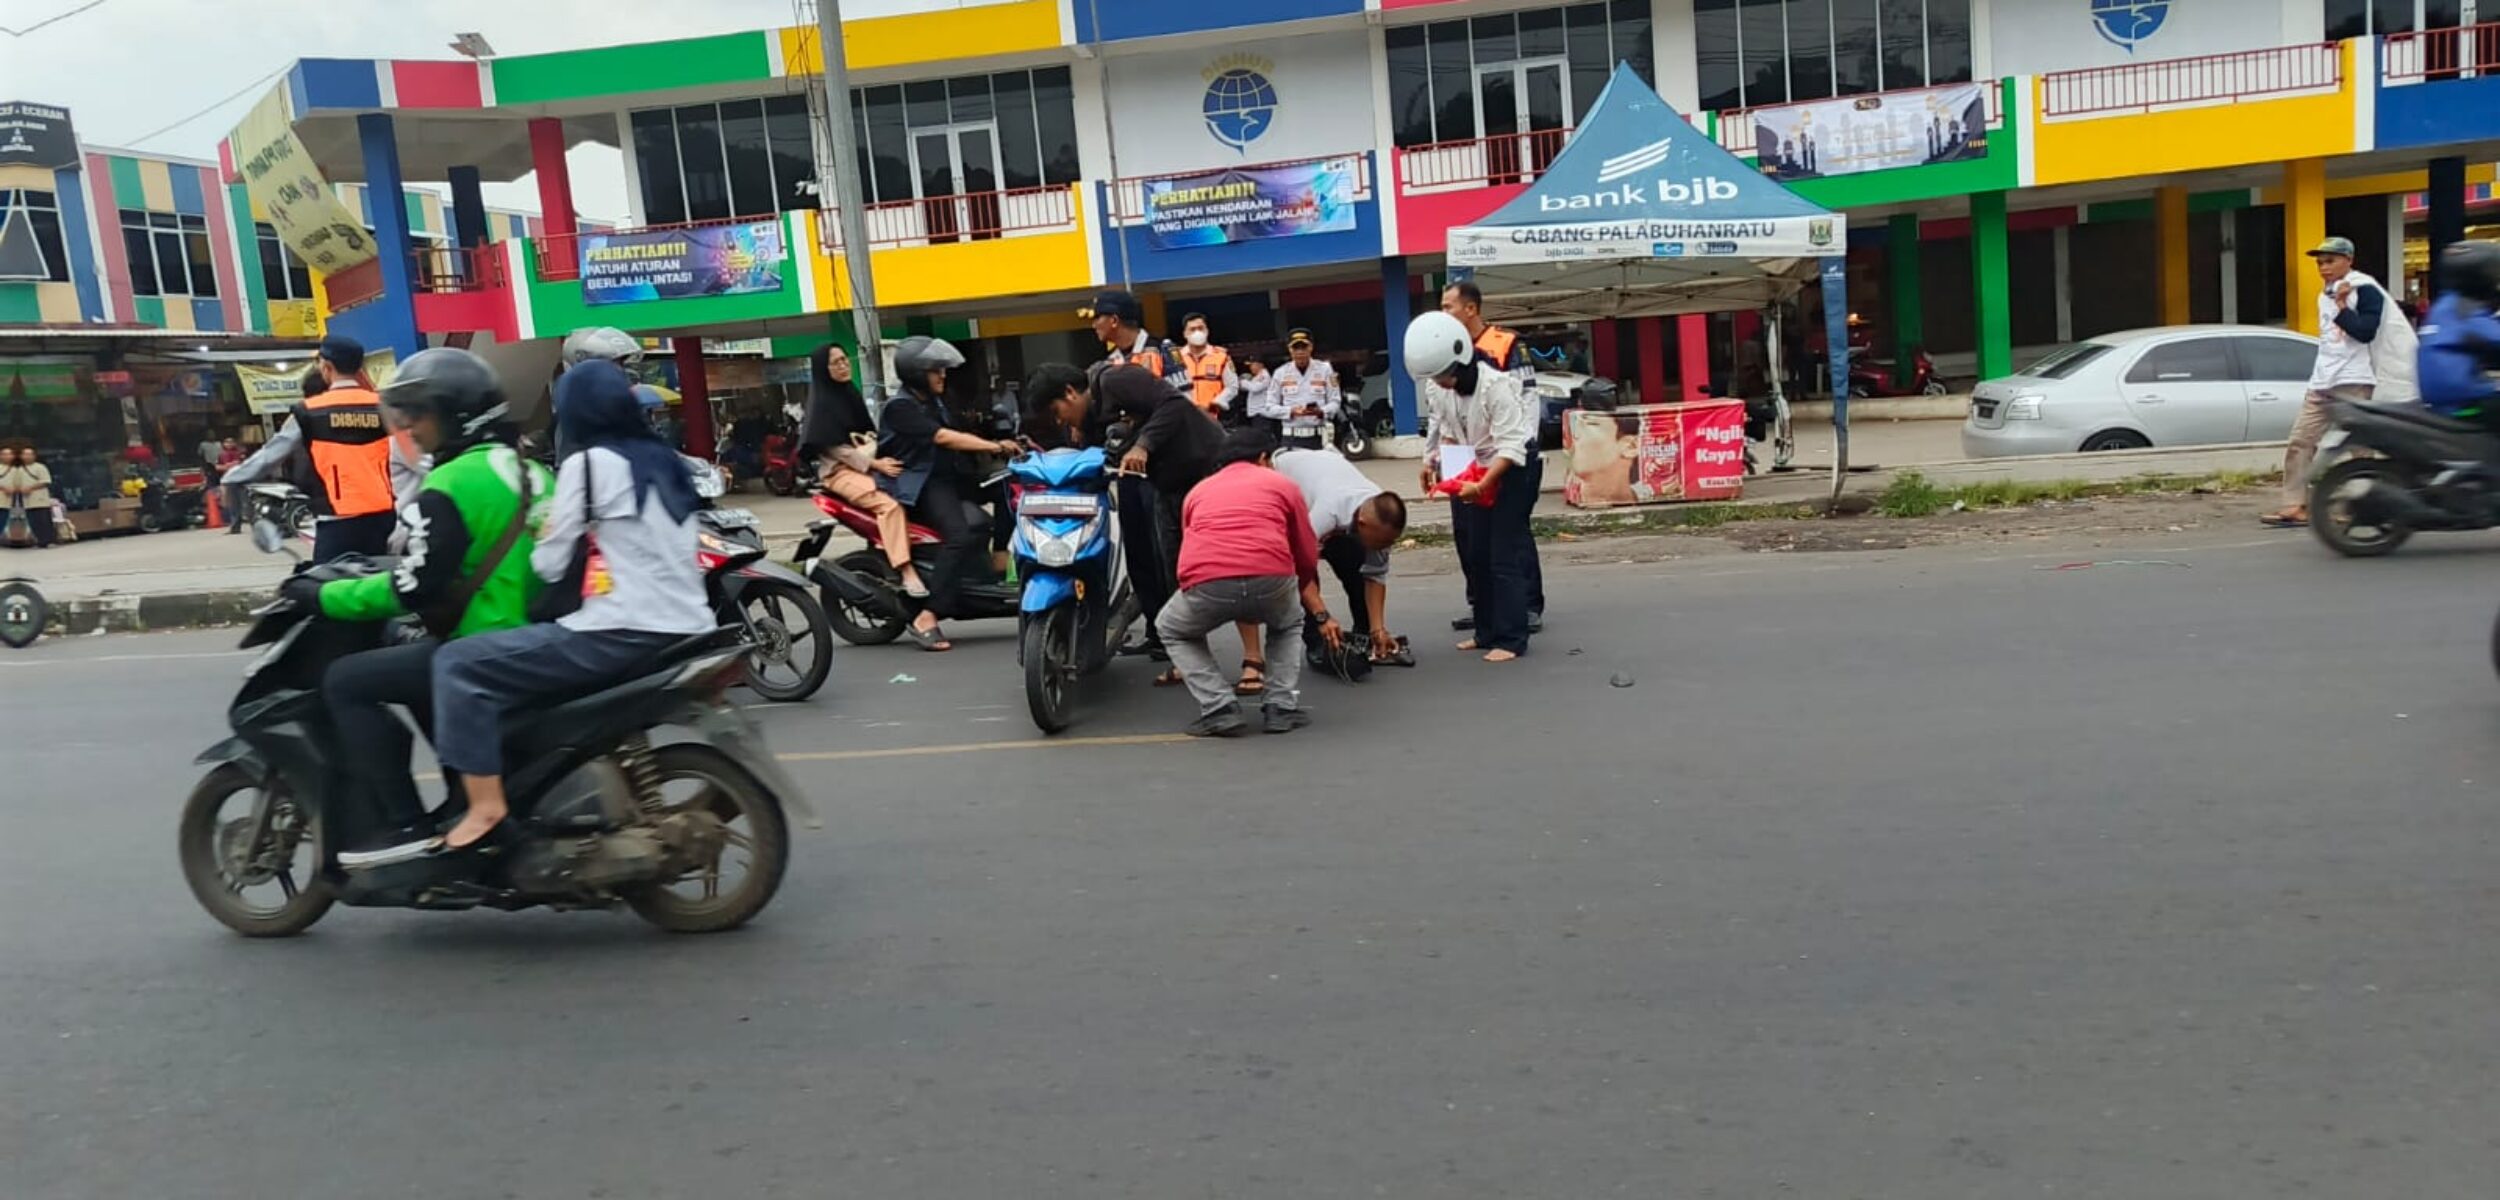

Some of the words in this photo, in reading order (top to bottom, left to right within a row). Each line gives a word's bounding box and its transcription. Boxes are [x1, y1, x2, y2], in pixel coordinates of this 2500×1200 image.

[1541, 186, 1646, 212] bank
[1657, 176, 1739, 204] bjb
[1152, 206, 1203, 220] PASTIKAN
[1206, 199, 1273, 214] KENDARAAN
[1153, 221, 1182, 233] YANG
[1184, 213, 1247, 230] DIGUNAKAN
[1511, 227, 1593, 244] CABANG
[1600, 222, 1776, 241] PALABUHANRATU
[1479, 246, 1497, 256] bjb
[587, 262, 628, 275] PATUHI
[631, 259, 680, 272] ATURAN
[330, 413, 380, 427] DISHUB
